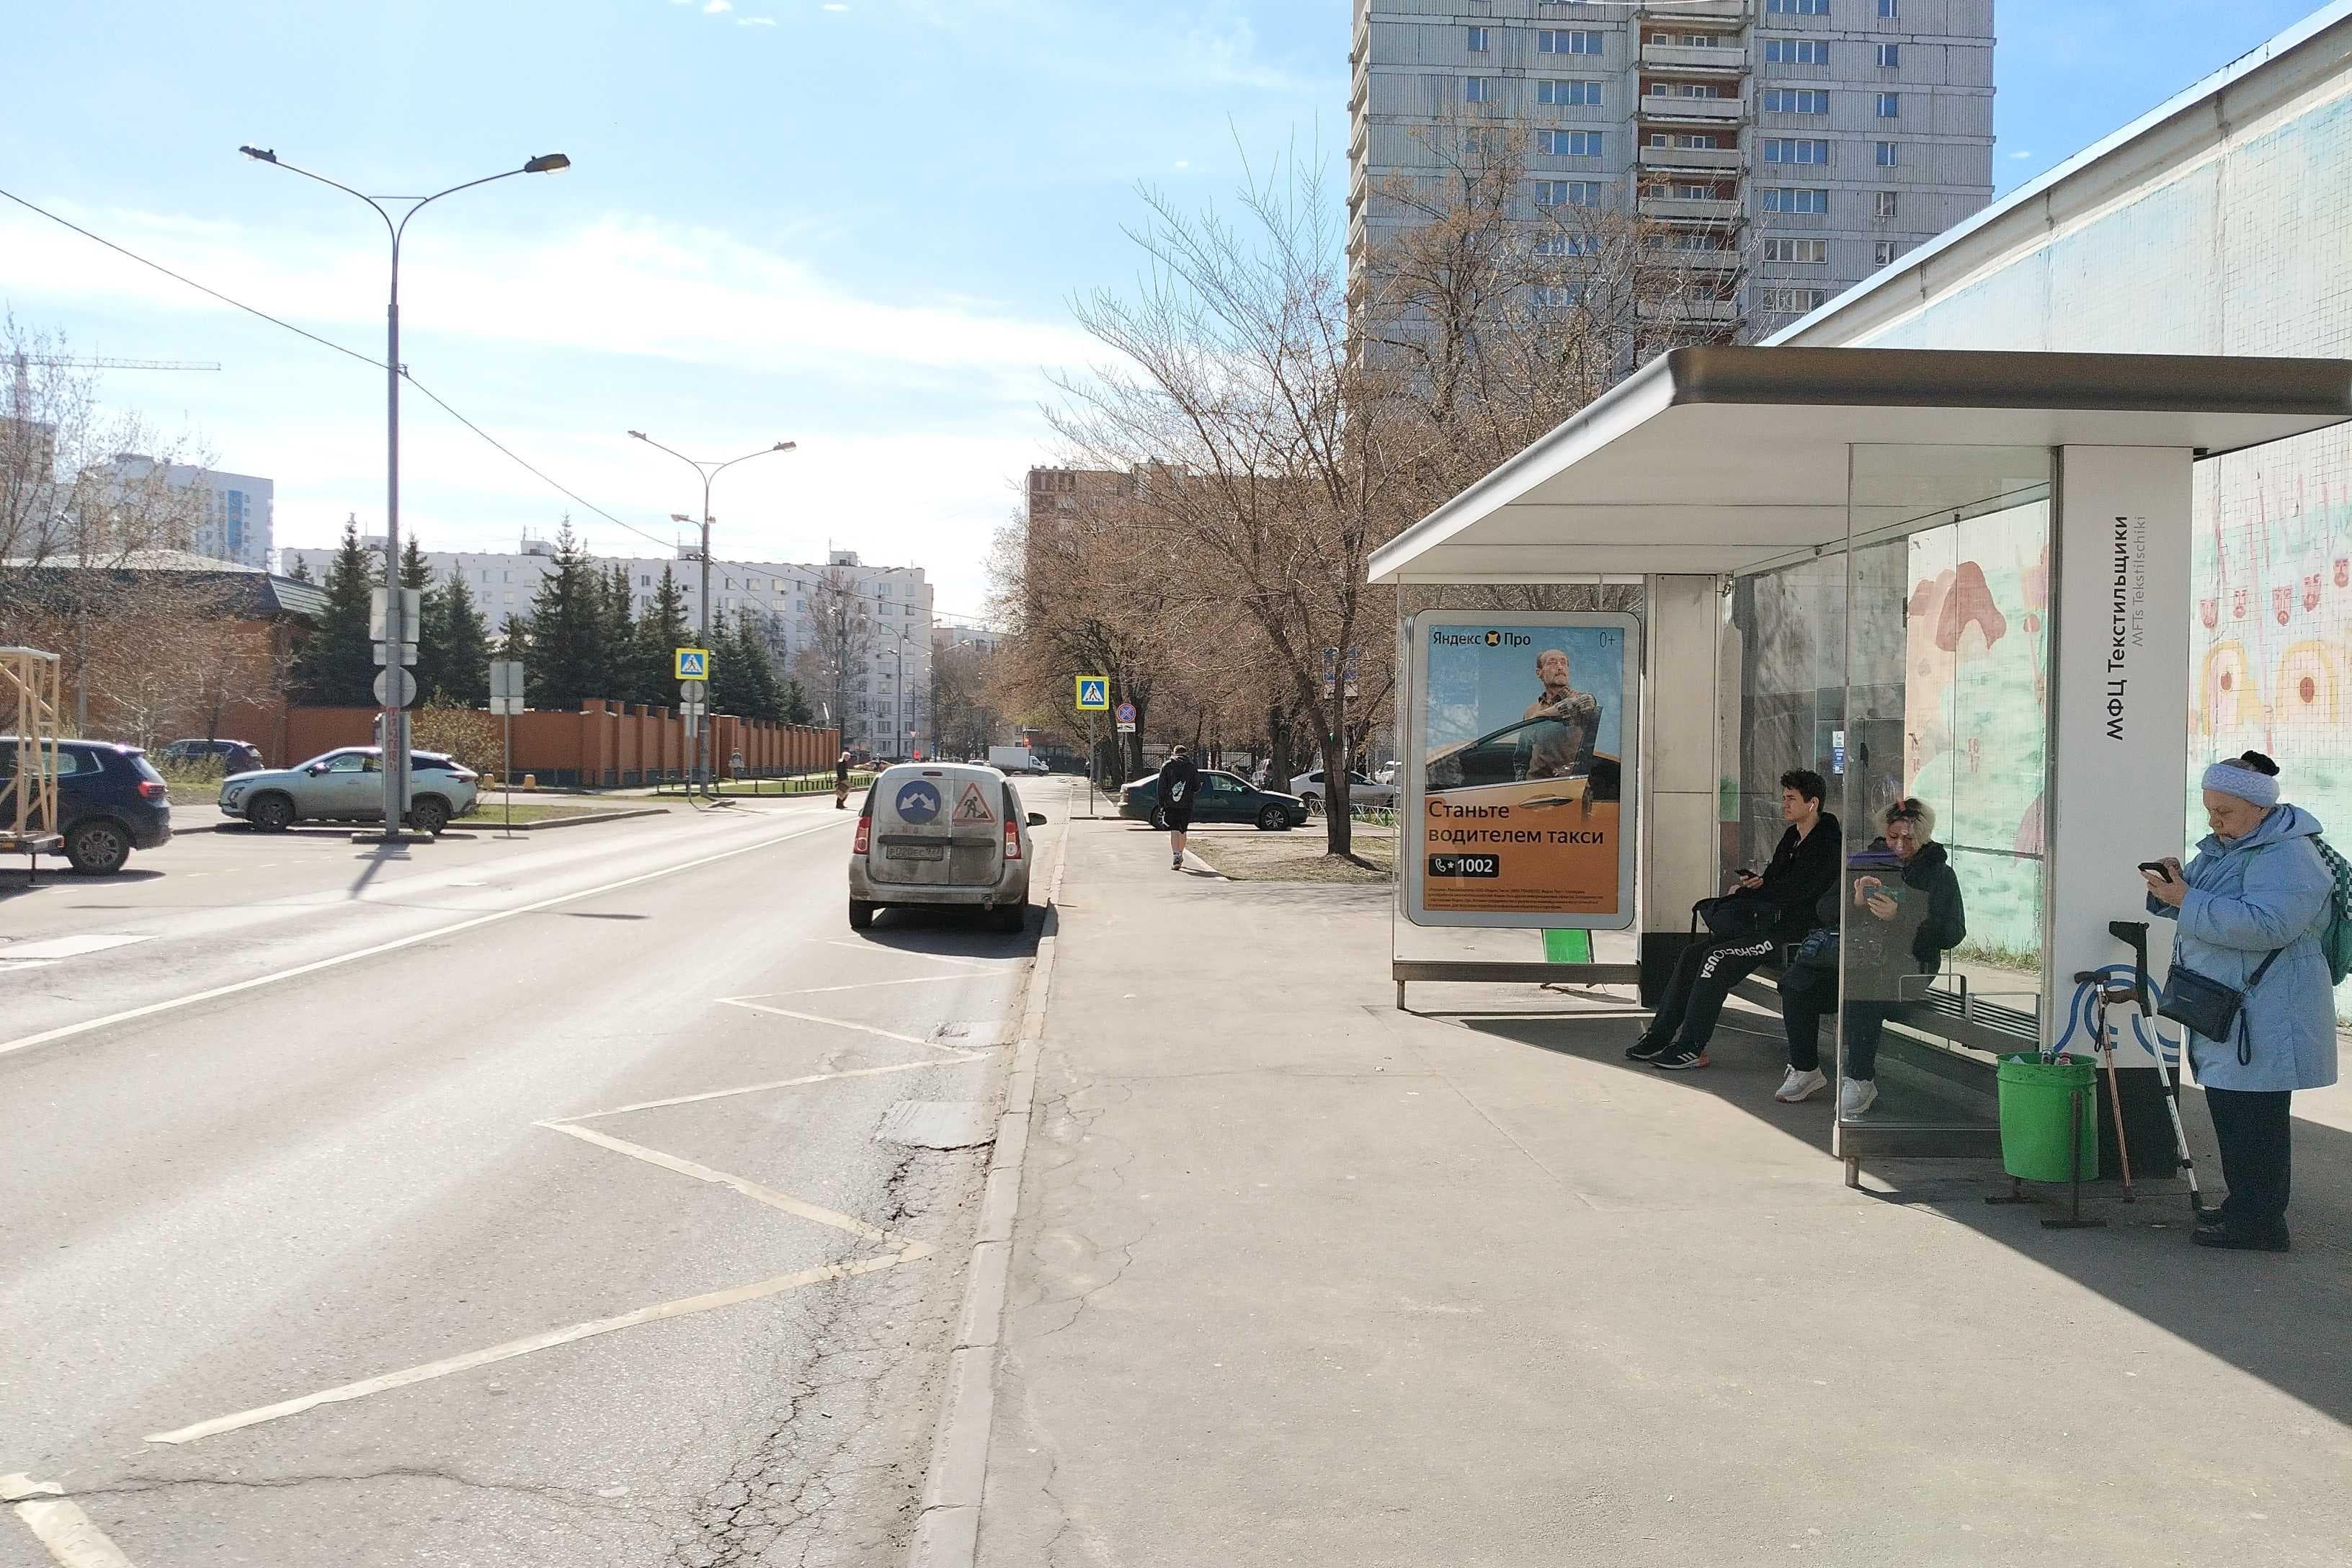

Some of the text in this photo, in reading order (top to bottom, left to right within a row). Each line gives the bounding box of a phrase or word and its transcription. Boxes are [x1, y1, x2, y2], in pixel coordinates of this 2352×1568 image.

[2132, 516, 2146, 647] MFTs Tekstilschiki
[2106, 516, 2130, 741] МФЦ Текстильщики
[1433, 631, 1532, 647] Яндекс Про
[1599, 631, 1616, 648] 0+
[1428, 801, 1510, 819] Станьте
[1428, 829, 1604, 845] водителем такси
